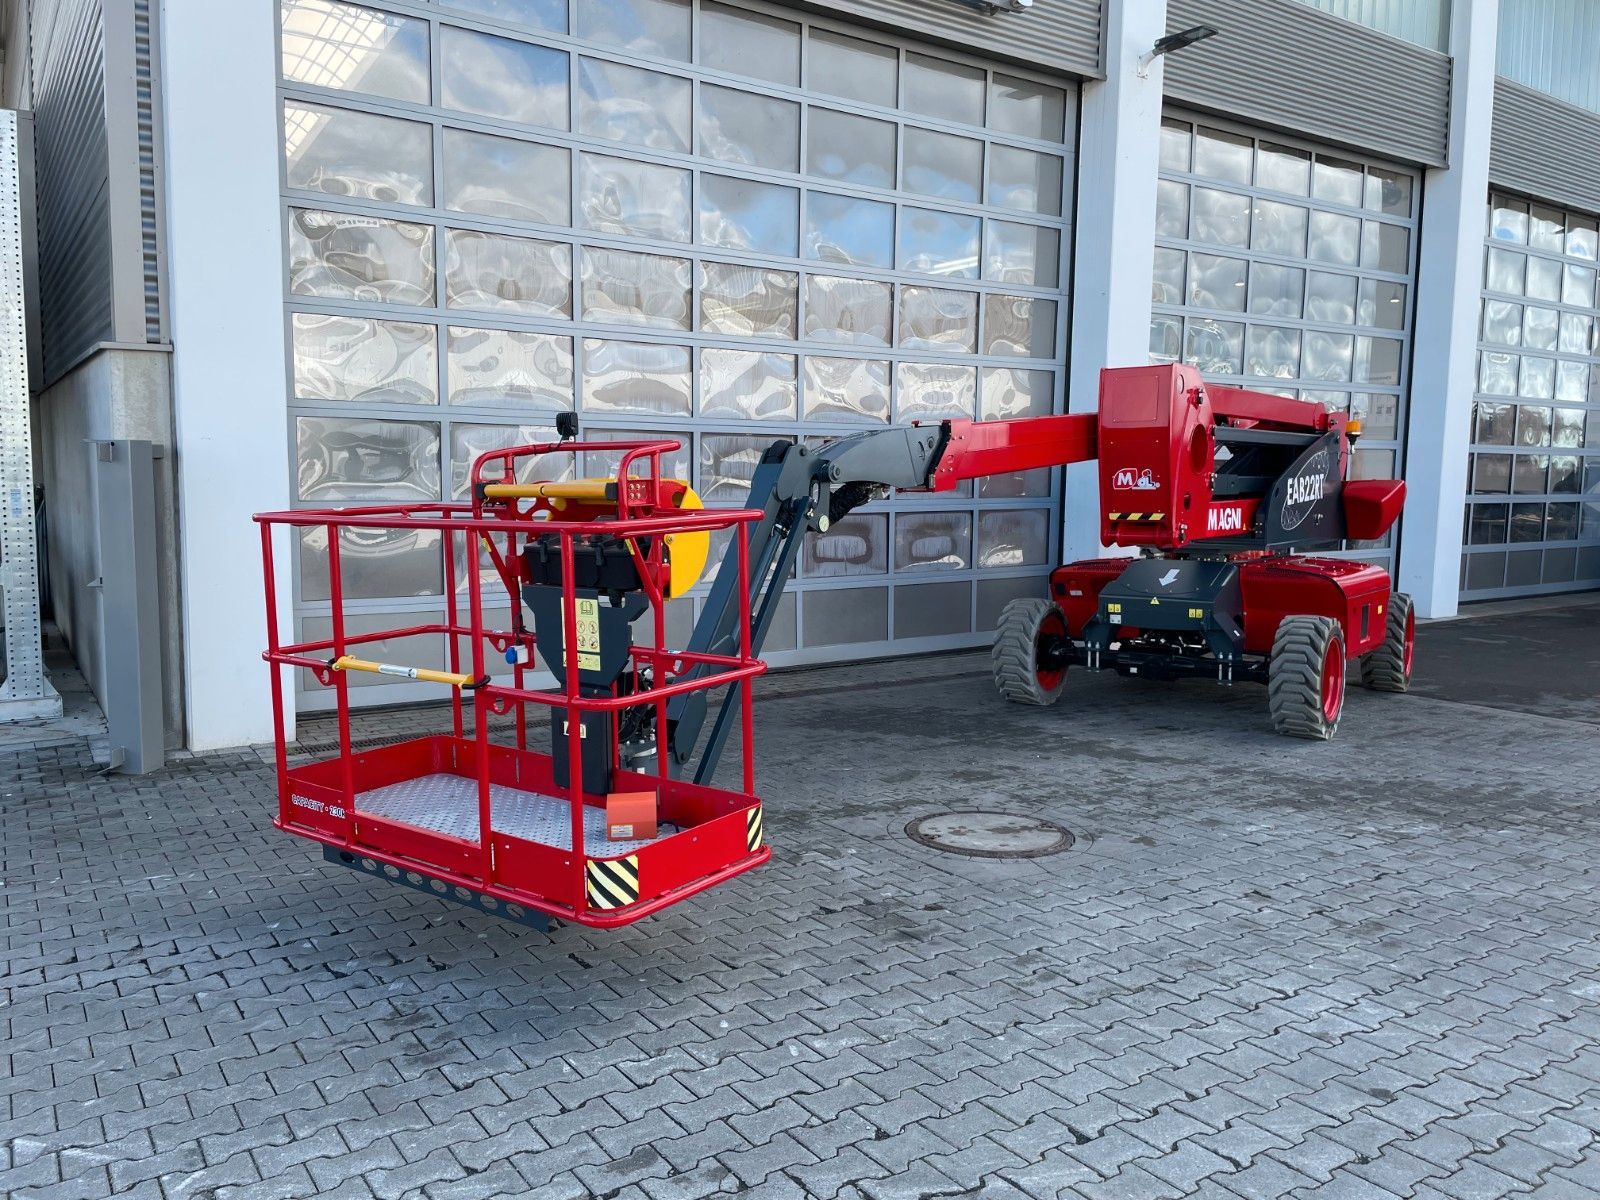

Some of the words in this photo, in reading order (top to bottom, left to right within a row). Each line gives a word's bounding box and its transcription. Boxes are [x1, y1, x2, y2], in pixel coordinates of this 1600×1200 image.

[1287, 473, 1325, 506] EAB22RT
[1207, 507, 1242, 531] MAGNI
[291, 793, 325, 813] CAPACITY
